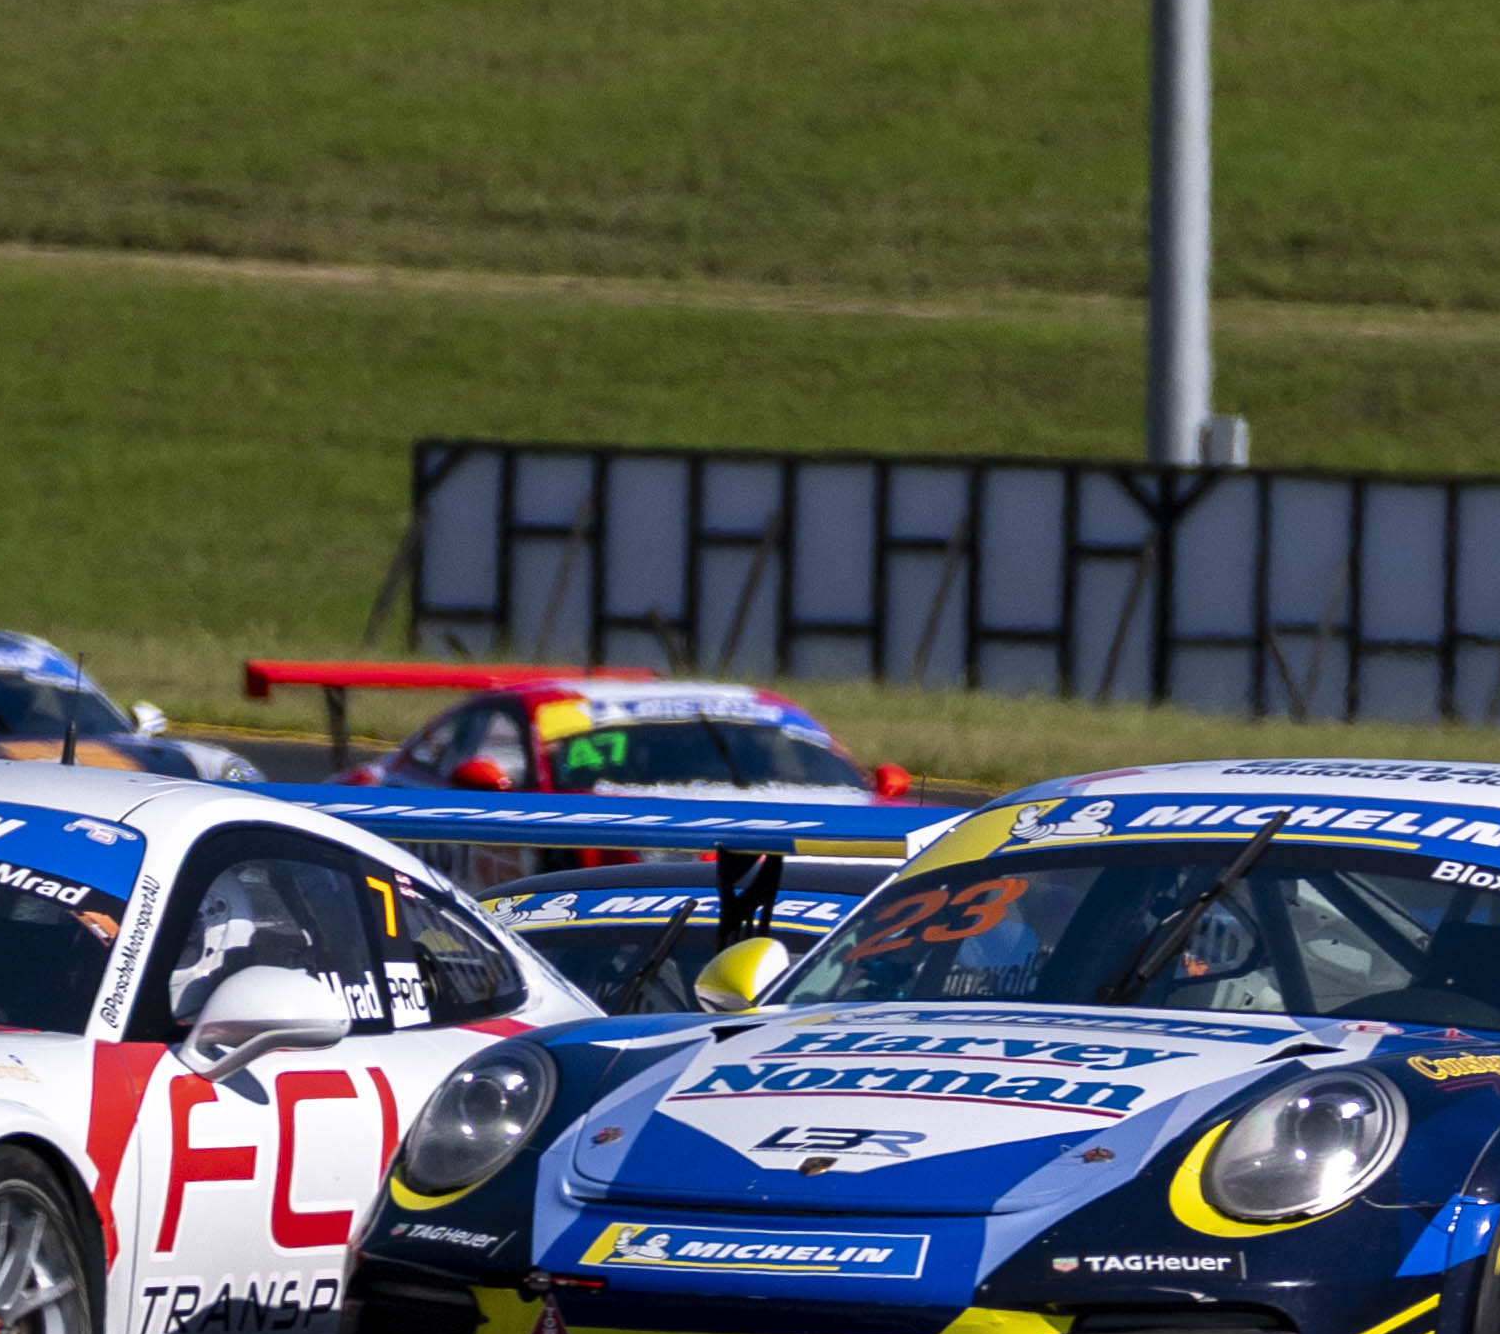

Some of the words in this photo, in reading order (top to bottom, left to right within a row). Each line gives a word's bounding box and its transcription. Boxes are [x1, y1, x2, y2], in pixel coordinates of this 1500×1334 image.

[567, 730, 627, 769] 47
[366, 875, 397, 938] 7
[841, 876, 1030, 963] 23
[389, 976, 428, 1012] PRO
[935, 1012, 1252, 1038] MICHELIN
[755, 1031, 1199, 1070] Harvey
[679, 1062, 1147, 1111] Norman
[406, 1221, 499, 1251] TAGHeuer
[676, 1239, 894, 1265] MICHELIN
[1081, 1253, 1232, 1273] TAGHeuer
